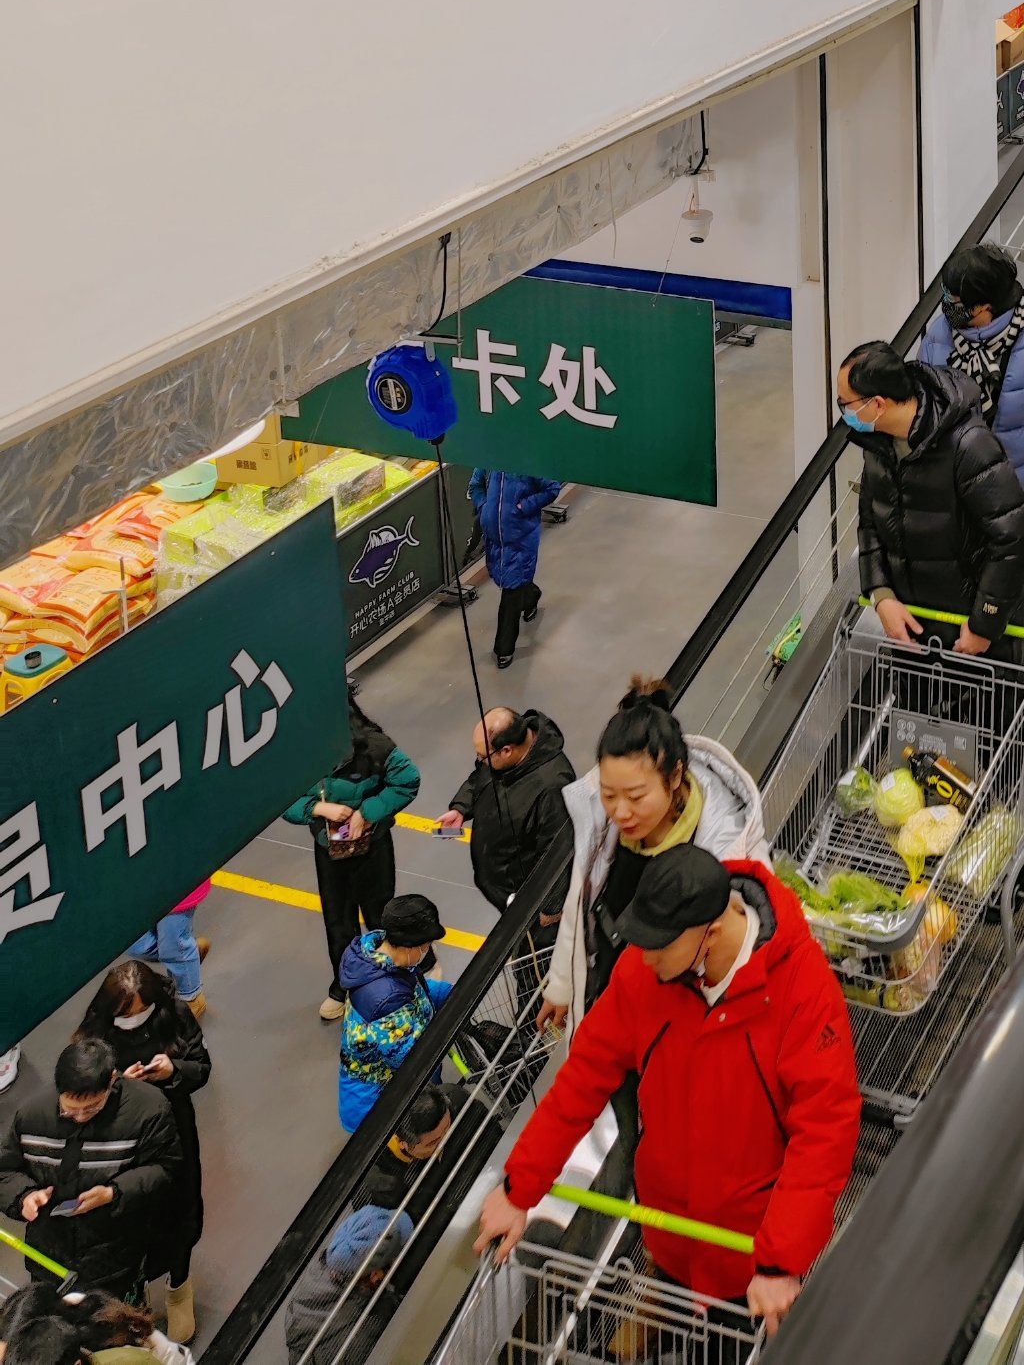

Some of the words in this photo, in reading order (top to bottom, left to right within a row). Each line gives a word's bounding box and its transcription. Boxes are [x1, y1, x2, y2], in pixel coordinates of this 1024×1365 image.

[452, 329, 618, 429] 卡处
[355, 598, 377, 619] HAPPY
[378, 585, 396, 602] FARM
[397, 571, 415, 587] CLUB
